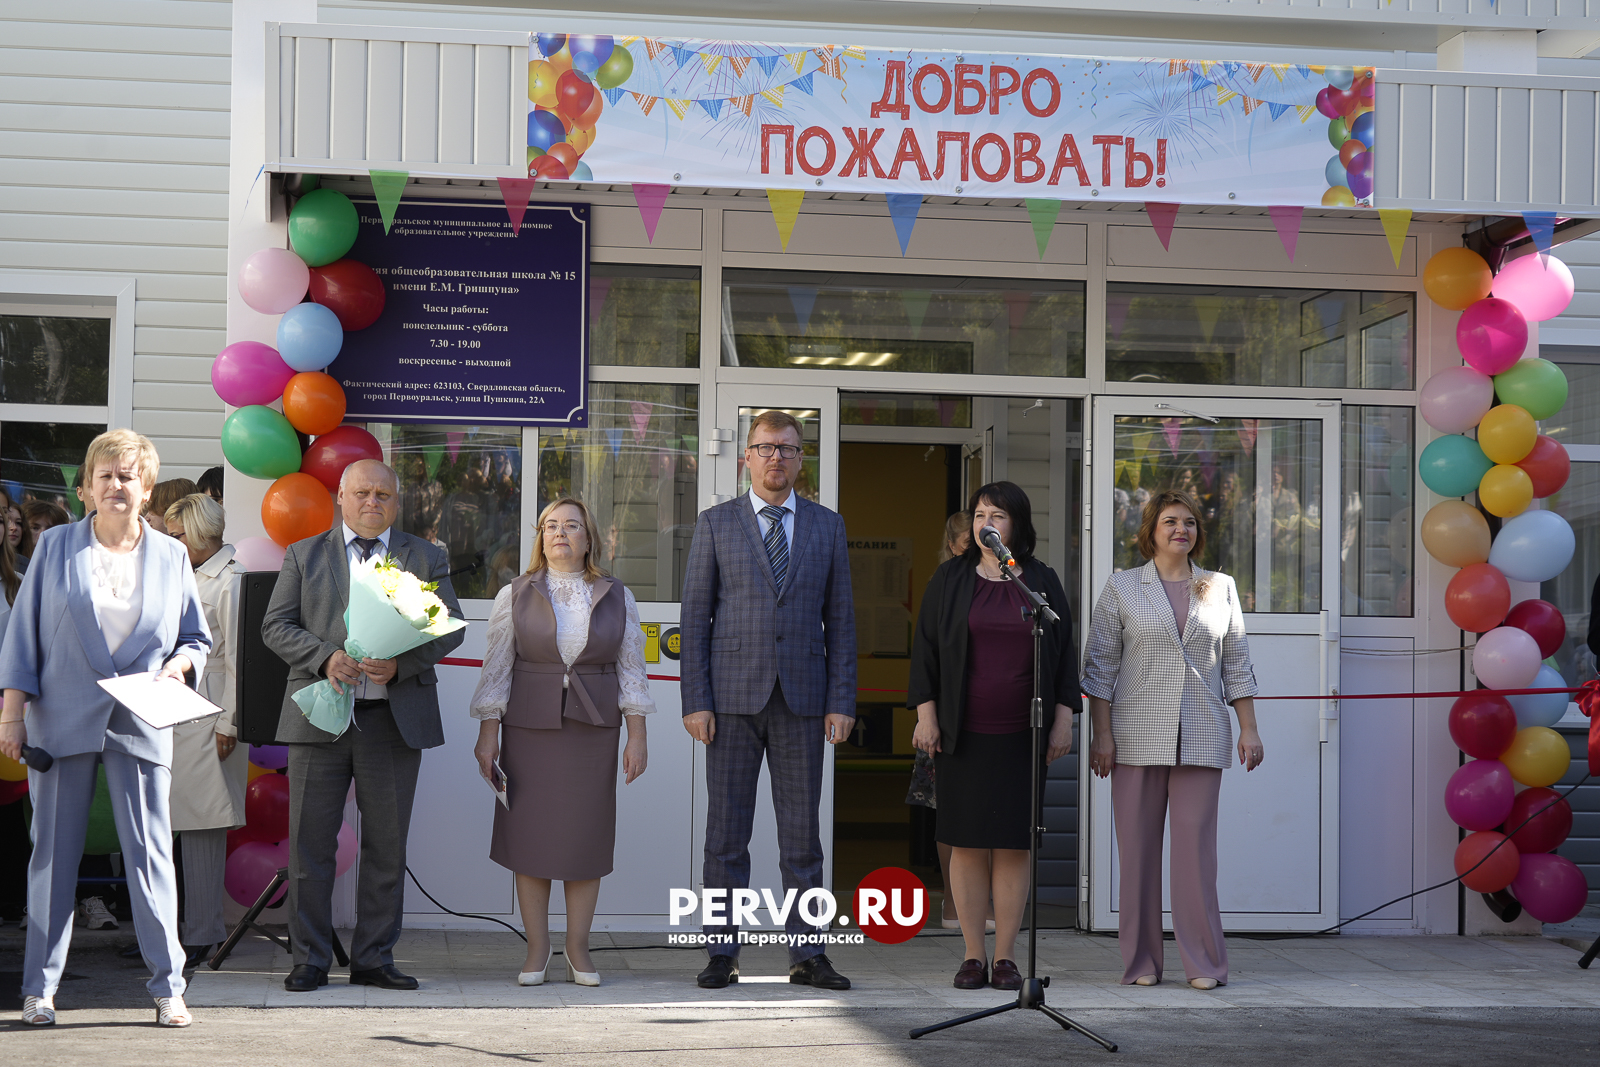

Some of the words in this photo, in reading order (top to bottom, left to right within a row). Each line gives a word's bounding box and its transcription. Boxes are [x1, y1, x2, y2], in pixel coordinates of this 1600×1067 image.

[870, 60, 1061, 120] ДОБРО
[760, 124, 1167, 188] ПОЖАЛОВАТЬ!
[361, 215, 431, 226] Первральское
[433, 219, 501, 228] муниципальное
[503, 222, 553, 230] авономное
[394, 227, 466, 236] образовательное
[468, 230, 519, 239] учреждение
[391, 266, 509, 279] общеобразовательная
[511, 271, 546, 280] школа
[549, 270, 561, 280] №
[564, 271, 576, 281] 15
[393, 283, 427, 291] имени
[430, 282, 455, 292] Е.М.
[458, 283, 520, 295] Гришпуна»
[423, 303, 448, 313] Часы
[451, 304, 489, 315] работы:
[403, 322, 464, 331] понедельник
[472, 323, 509, 333] суббота
[430, 339, 449, 348] 7.30
[457, 340, 481, 349] 19.00
[398, 357, 457, 367] воскресенье
[465, 359, 511, 368] выходной
[343, 379, 402, 389] Фактический
[404, 382, 431, 391] адрес:
[433, 382, 465, 391] 623103,
[467, 382, 528, 393] Свердловская
[529, 384, 566, 393] область,
[363, 393, 387, 401] город
[389, 393, 453, 403] Первоуральск,
[455, 396, 481, 404] улица
[483, 395, 527, 404] Пушкина,
[528, 396, 545, 404] 22А
[846, 541, 897, 550] ИСАНИЕ
